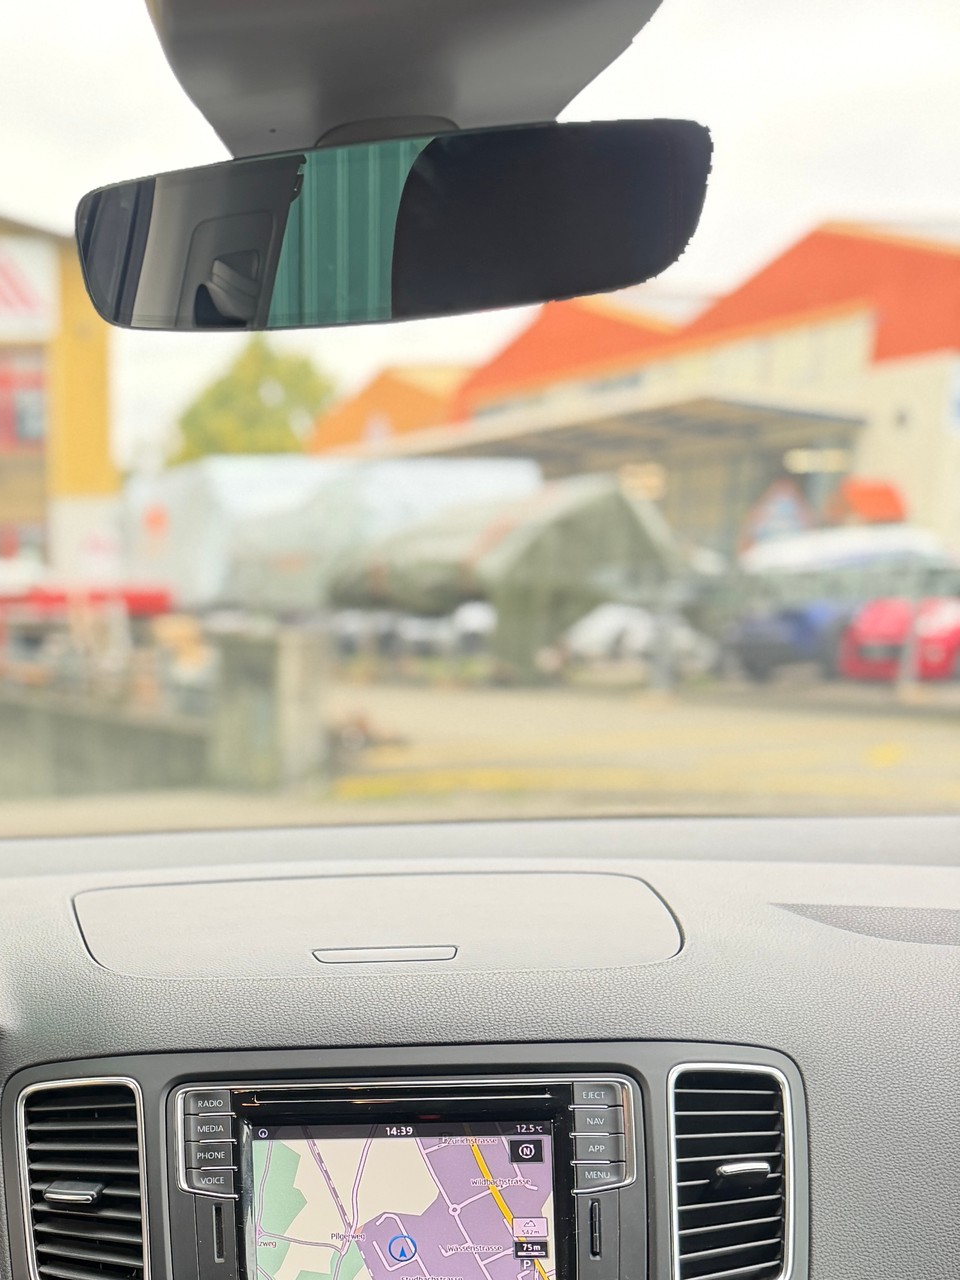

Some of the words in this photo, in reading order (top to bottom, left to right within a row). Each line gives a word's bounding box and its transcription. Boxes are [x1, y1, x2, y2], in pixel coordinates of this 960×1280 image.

[582, 1091, 605, 1099] EJECT
[197, 1099, 224, 1108] RADIO
[586, 1117, 605, 1125] NAV
[197, 1125, 224, 1133] MEDIA
[385, 1126, 413, 1136] 14:39
[588, 1145, 605, 1153] APP
[196, 1151, 226, 1160] PHONE
[585, 1171, 611, 1179] MENU
[200, 1176, 225, 1185] VOICE
